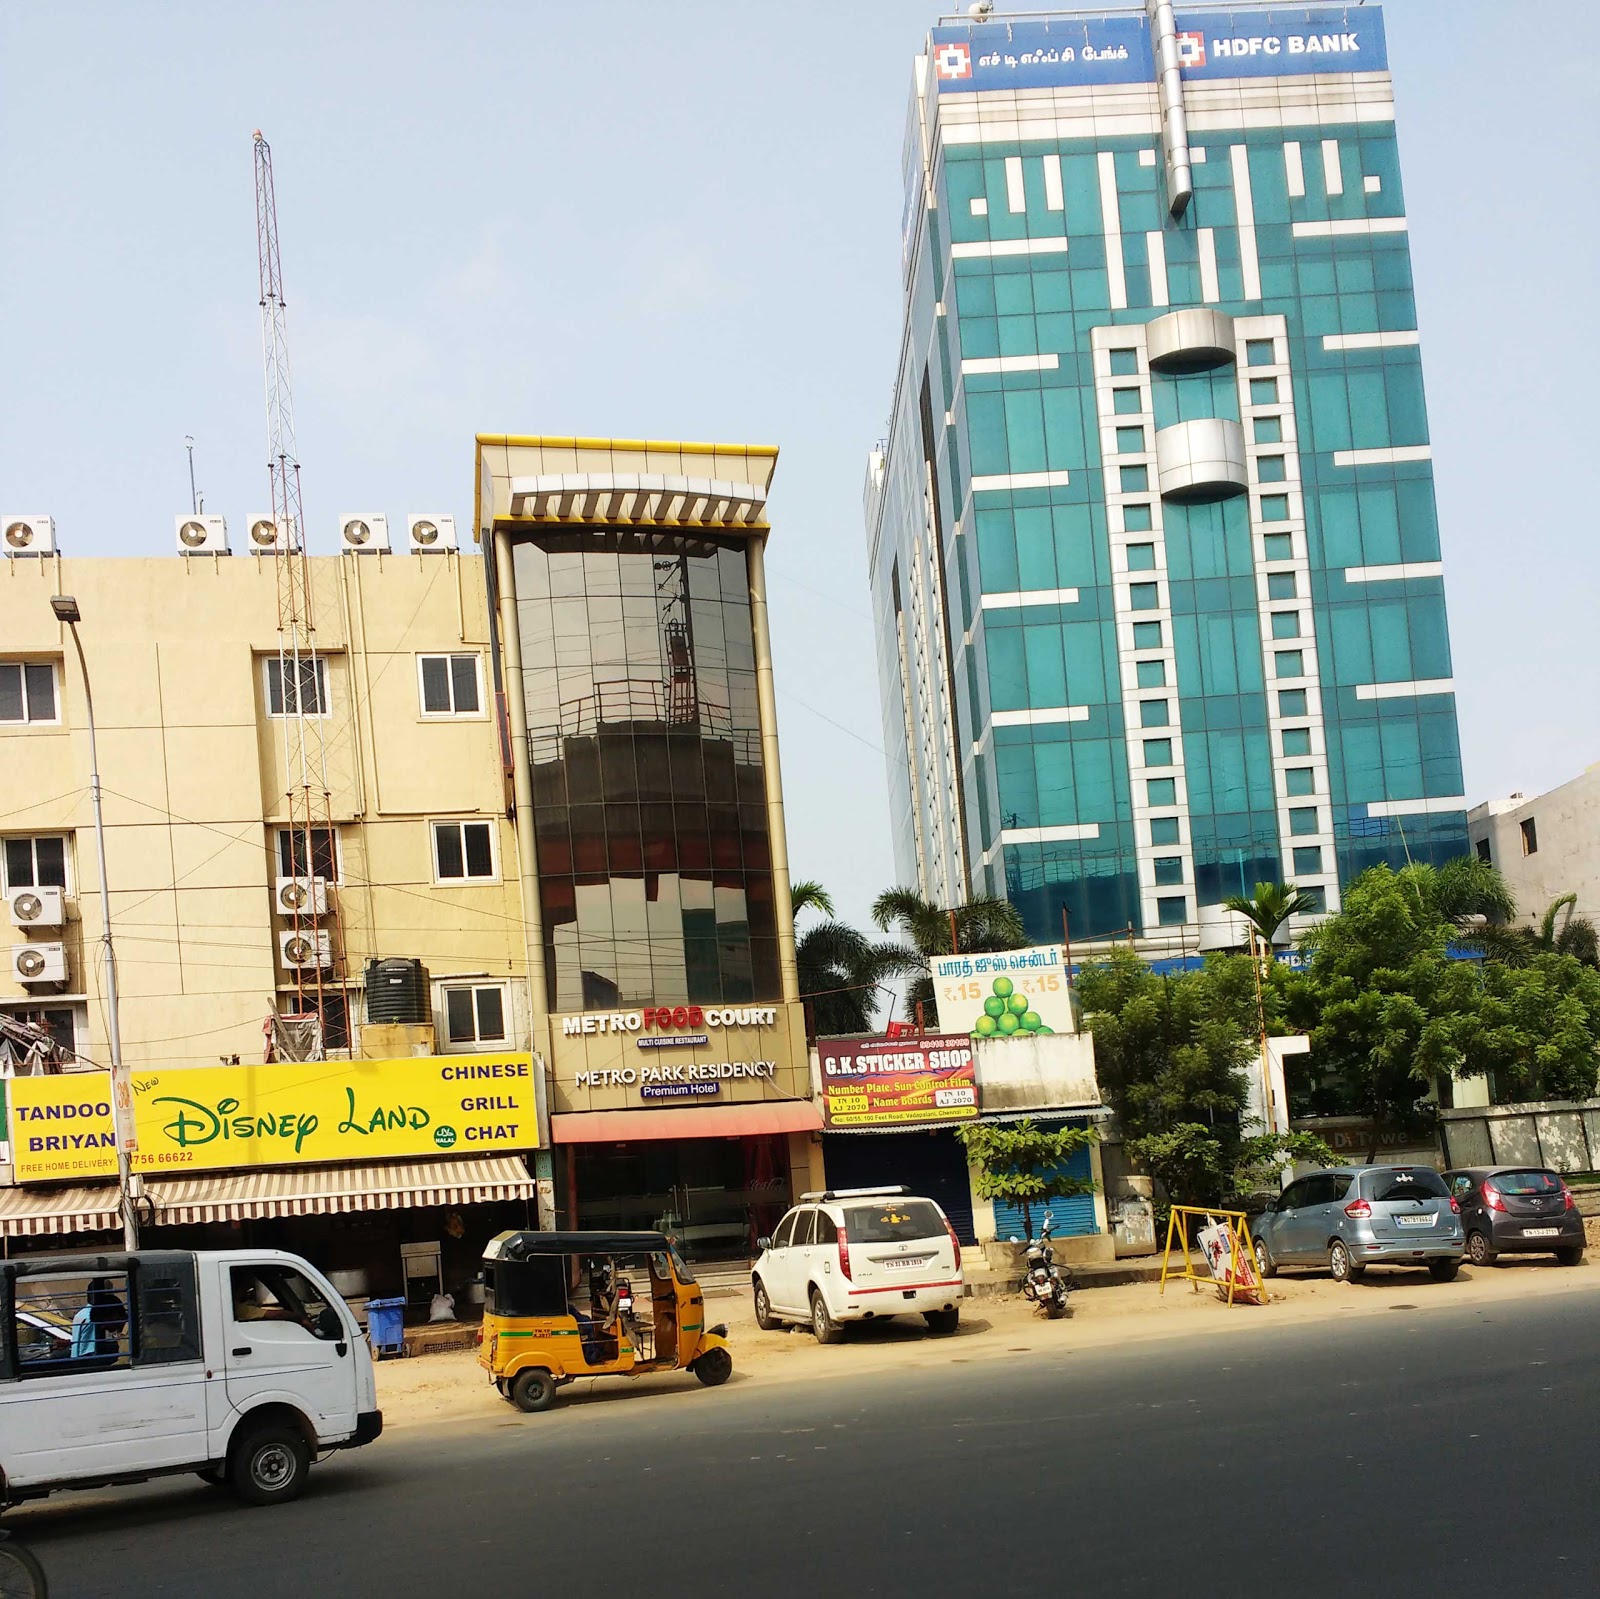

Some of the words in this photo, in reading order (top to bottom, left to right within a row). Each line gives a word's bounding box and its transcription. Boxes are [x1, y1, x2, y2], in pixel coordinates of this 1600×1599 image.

[1081, 44, 1129, 61] பேங்க்
[1213, 36, 1281, 57] HDFC
[1288, 33, 1361, 53] BANK
[938, 956, 973, 978] பாரத்
[1010, 947, 1058, 969] சென்டர்
[562, 1012, 642, 1035] METRO
[643, 1006, 704, 1030] FOOD
[705, 1007, 777, 1027] COURT
[638, 1038, 654, 1047] MULTI
[654, 1037, 675, 1046] CUISINE
[675, 1036, 707, 1045] RESTAURANT
[825, 1052, 926, 1075] G.K.STICKER
[928, 1049, 972, 1069] SHOP
[441, 1063, 529, 1081] CHINESE
[575, 1067, 636, 1087] METRO
[641, 1064, 685, 1083] PARK
[688, 1061, 776, 1080] RESIDENCY
[644, 1085, 688, 1097] Premium
[691, 1084, 717, 1094] Hotel
[828, 1084, 864, 1095] Number
[894, 1081, 912, 1091] Sun
[914, 1079, 948, 1090] Control
[949, 1077, 973, 1088] Film.
[461, 1095, 519, 1111] GRILL
[873, 1097, 899, 1108] Name
[901, 1095, 933, 1106] Boards
[16, 1102, 111, 1122] TANDOO
[435, 1136, 456, 1144] HALAL
[465, 1124, 519, 1141] CHAT
[29, 1132, 116, 1152] BRIYAN
[158, 1151, 193, 1163] 66622
[21, 1163, 43, 1173] FREE
[45, 1161, 70, 1171] HOME
[73, 1159, 116, 1169] DELIVERY:
